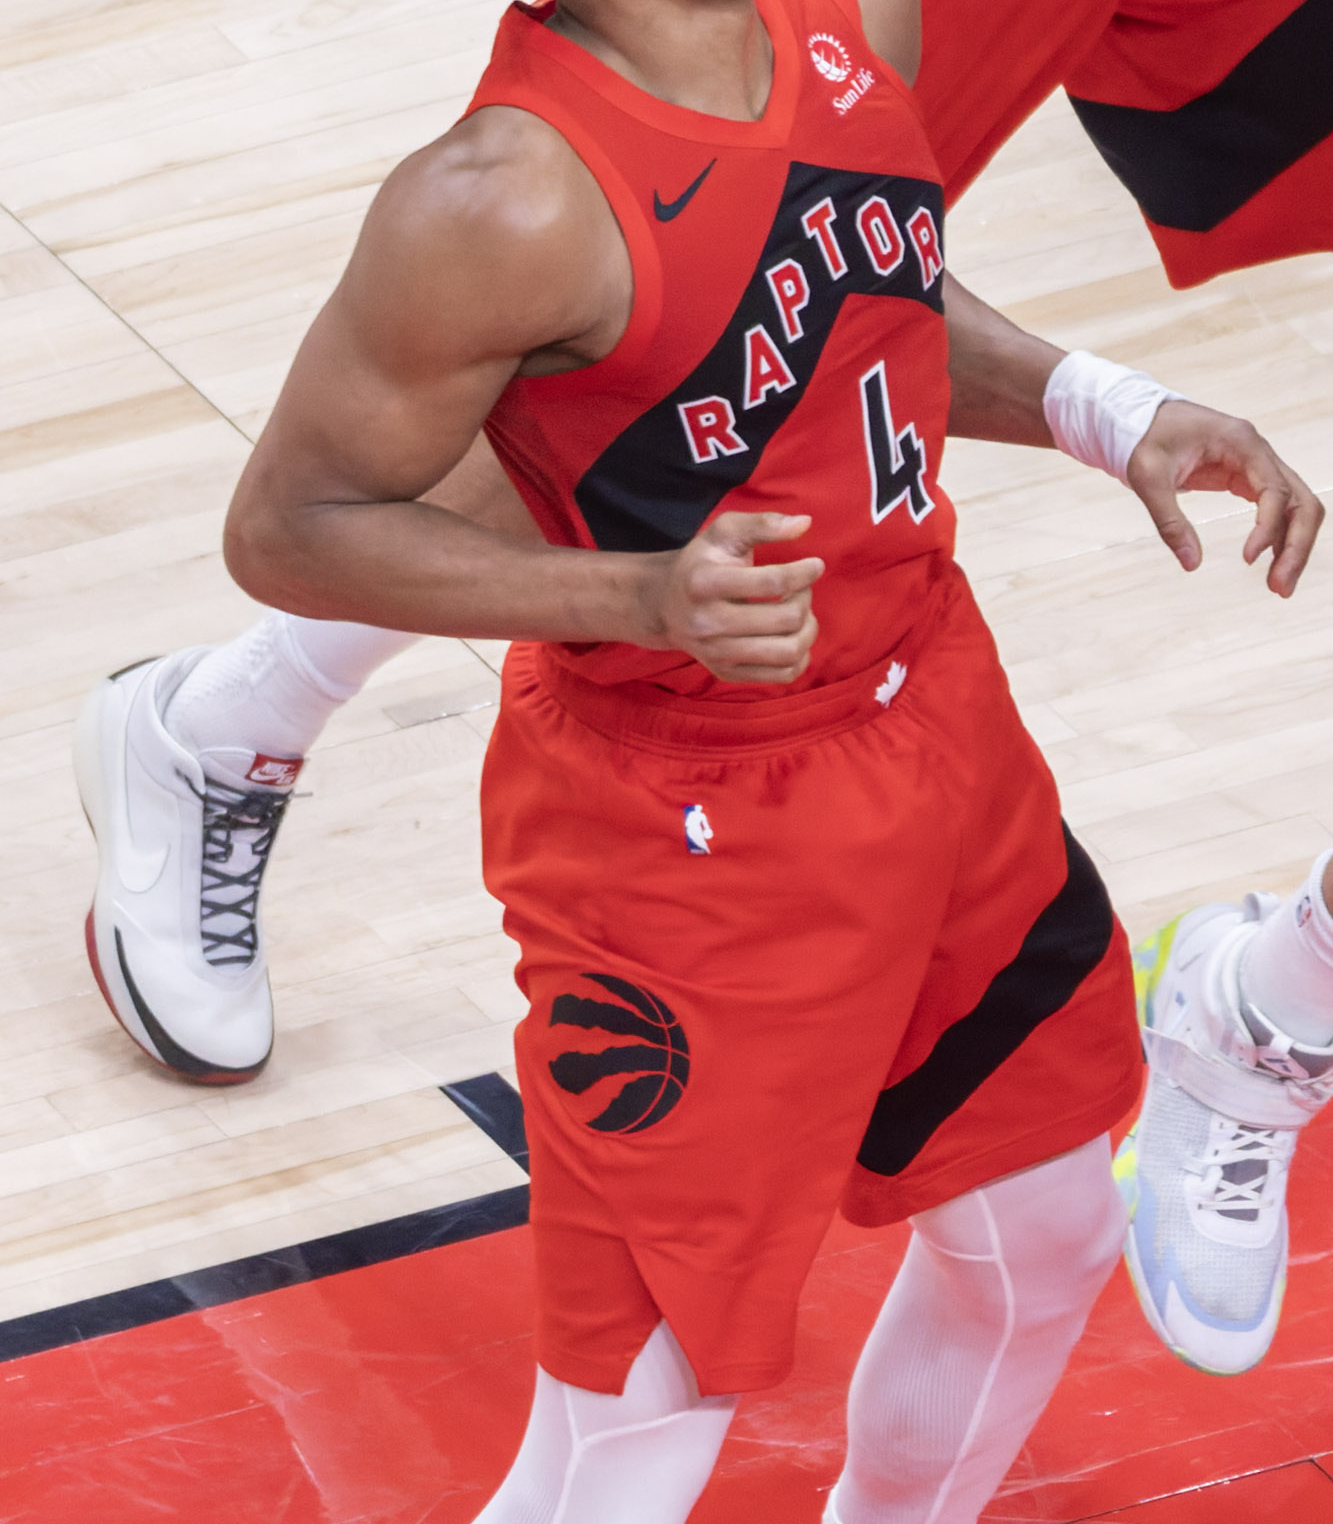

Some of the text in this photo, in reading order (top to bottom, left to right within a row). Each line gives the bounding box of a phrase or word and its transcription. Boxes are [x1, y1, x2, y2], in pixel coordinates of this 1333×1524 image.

[832, 67, 876, 116] Sun Life
[677, 195, 943, 463] RAPTOR
[859, 359, 936, 525] 4
